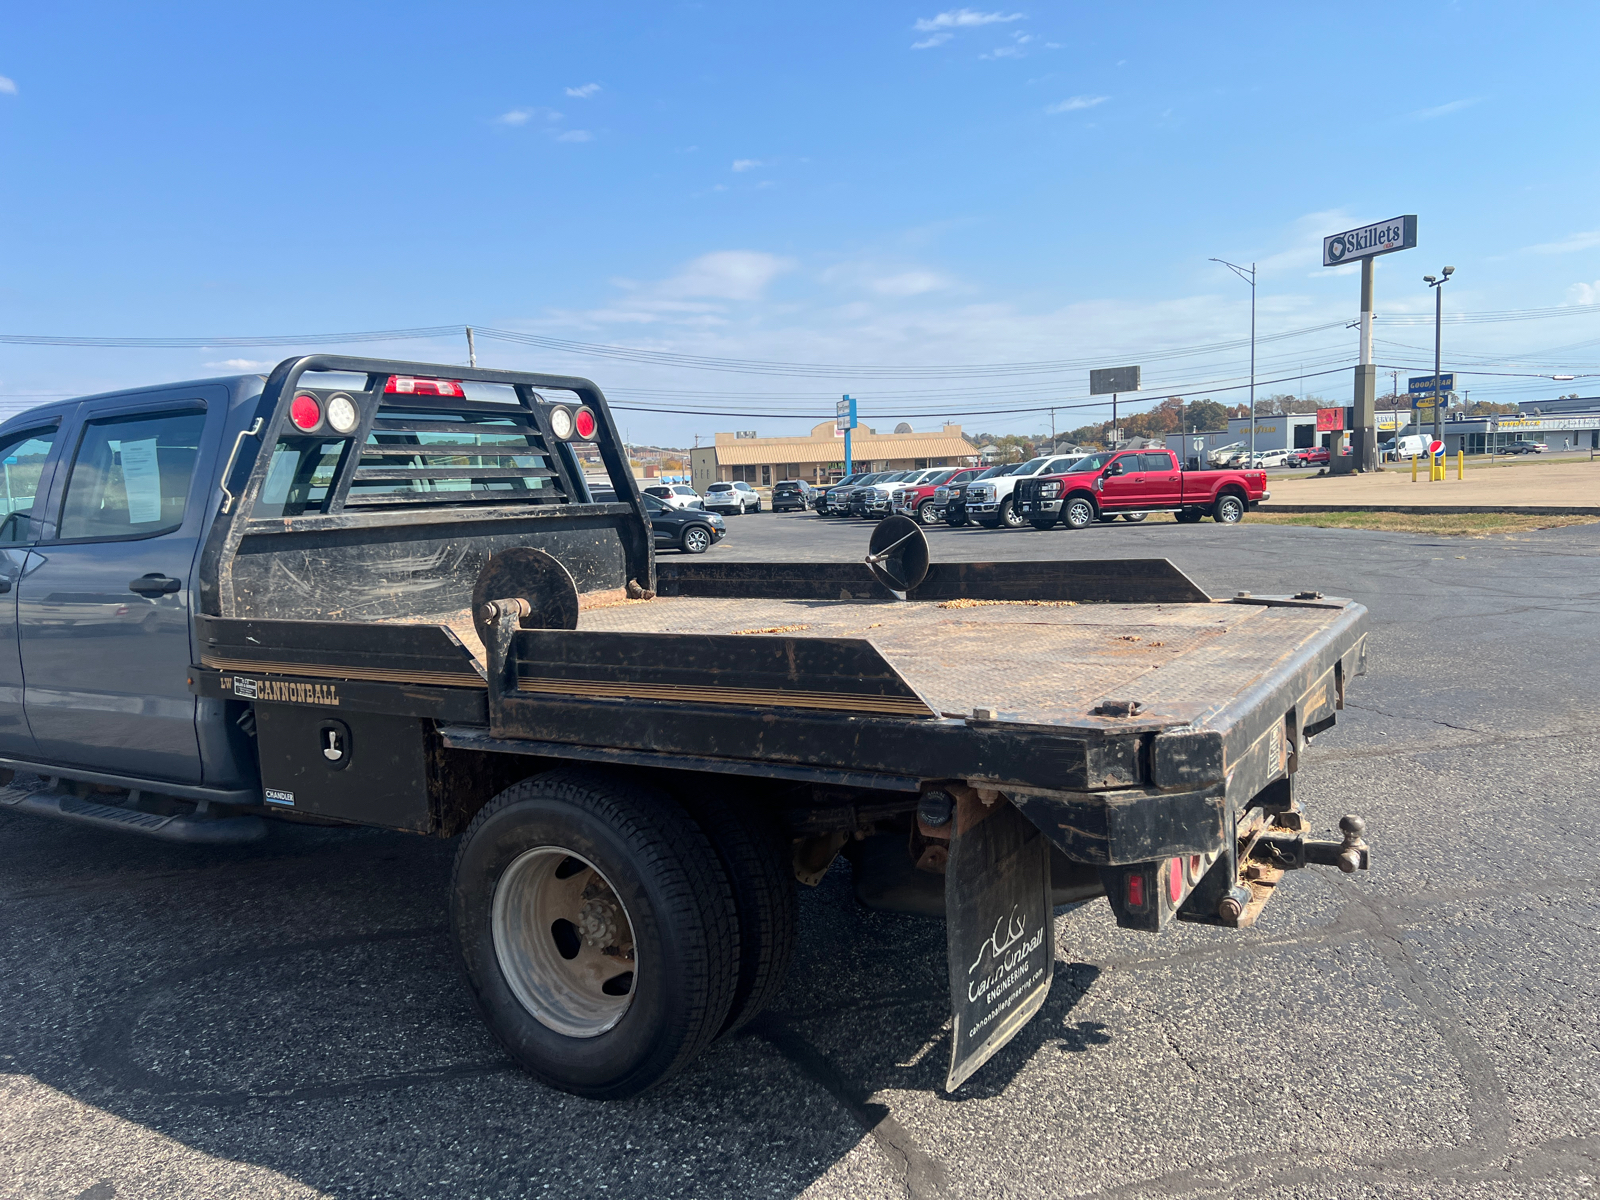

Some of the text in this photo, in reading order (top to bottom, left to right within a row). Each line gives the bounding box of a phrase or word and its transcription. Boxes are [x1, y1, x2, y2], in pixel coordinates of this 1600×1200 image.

[1347, 225, 1400, 253] Skillets
[257, 680, 339, 705] CANNONBALL
[265, 790, 294, 801] CHANDLER
[986, 961, 1029, 1004] ENGINEERING
